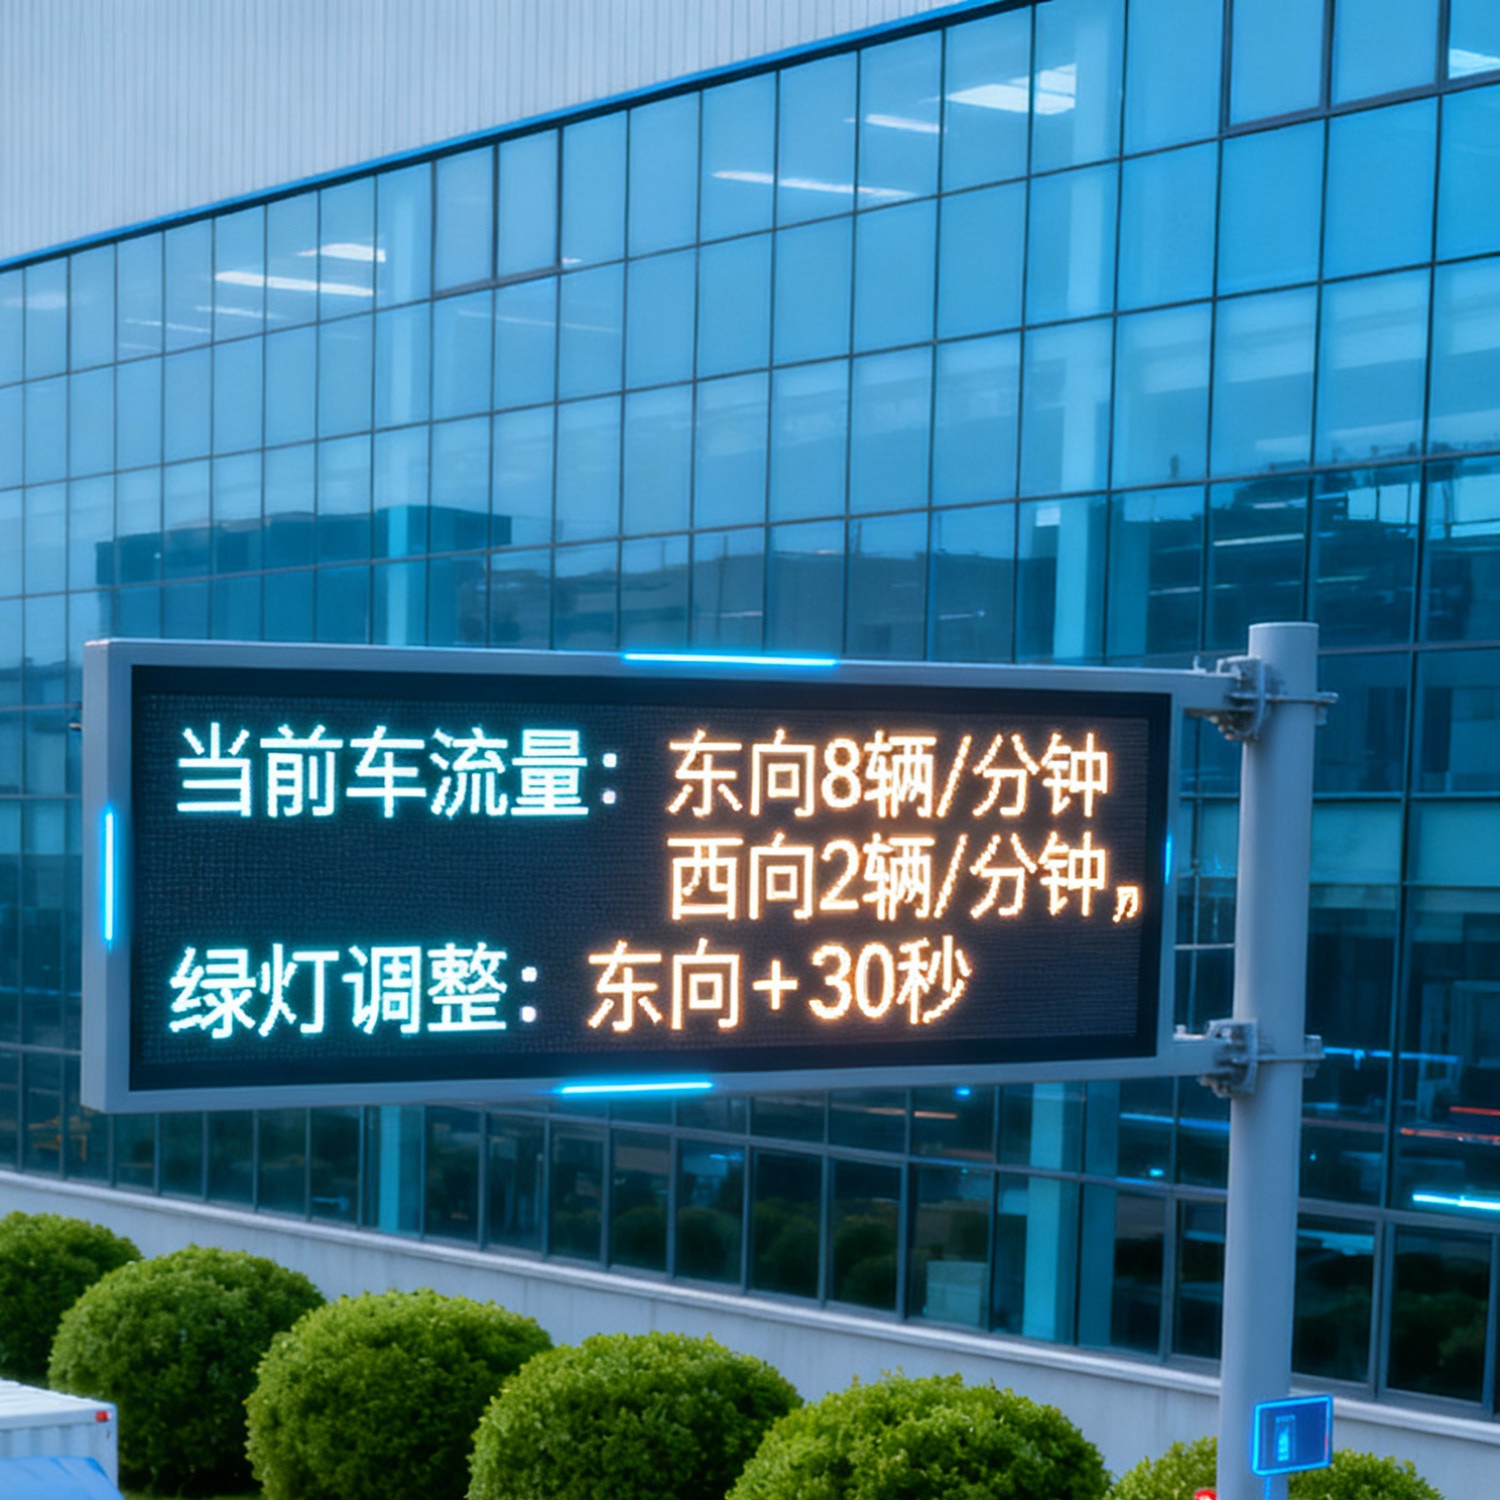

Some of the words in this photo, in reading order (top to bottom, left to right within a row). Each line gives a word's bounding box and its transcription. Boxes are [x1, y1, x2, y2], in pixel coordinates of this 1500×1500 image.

[667, 727, 1109, 818] 东向8辆/分钟
[587, 935, 972, 1032] 东向+30秒
